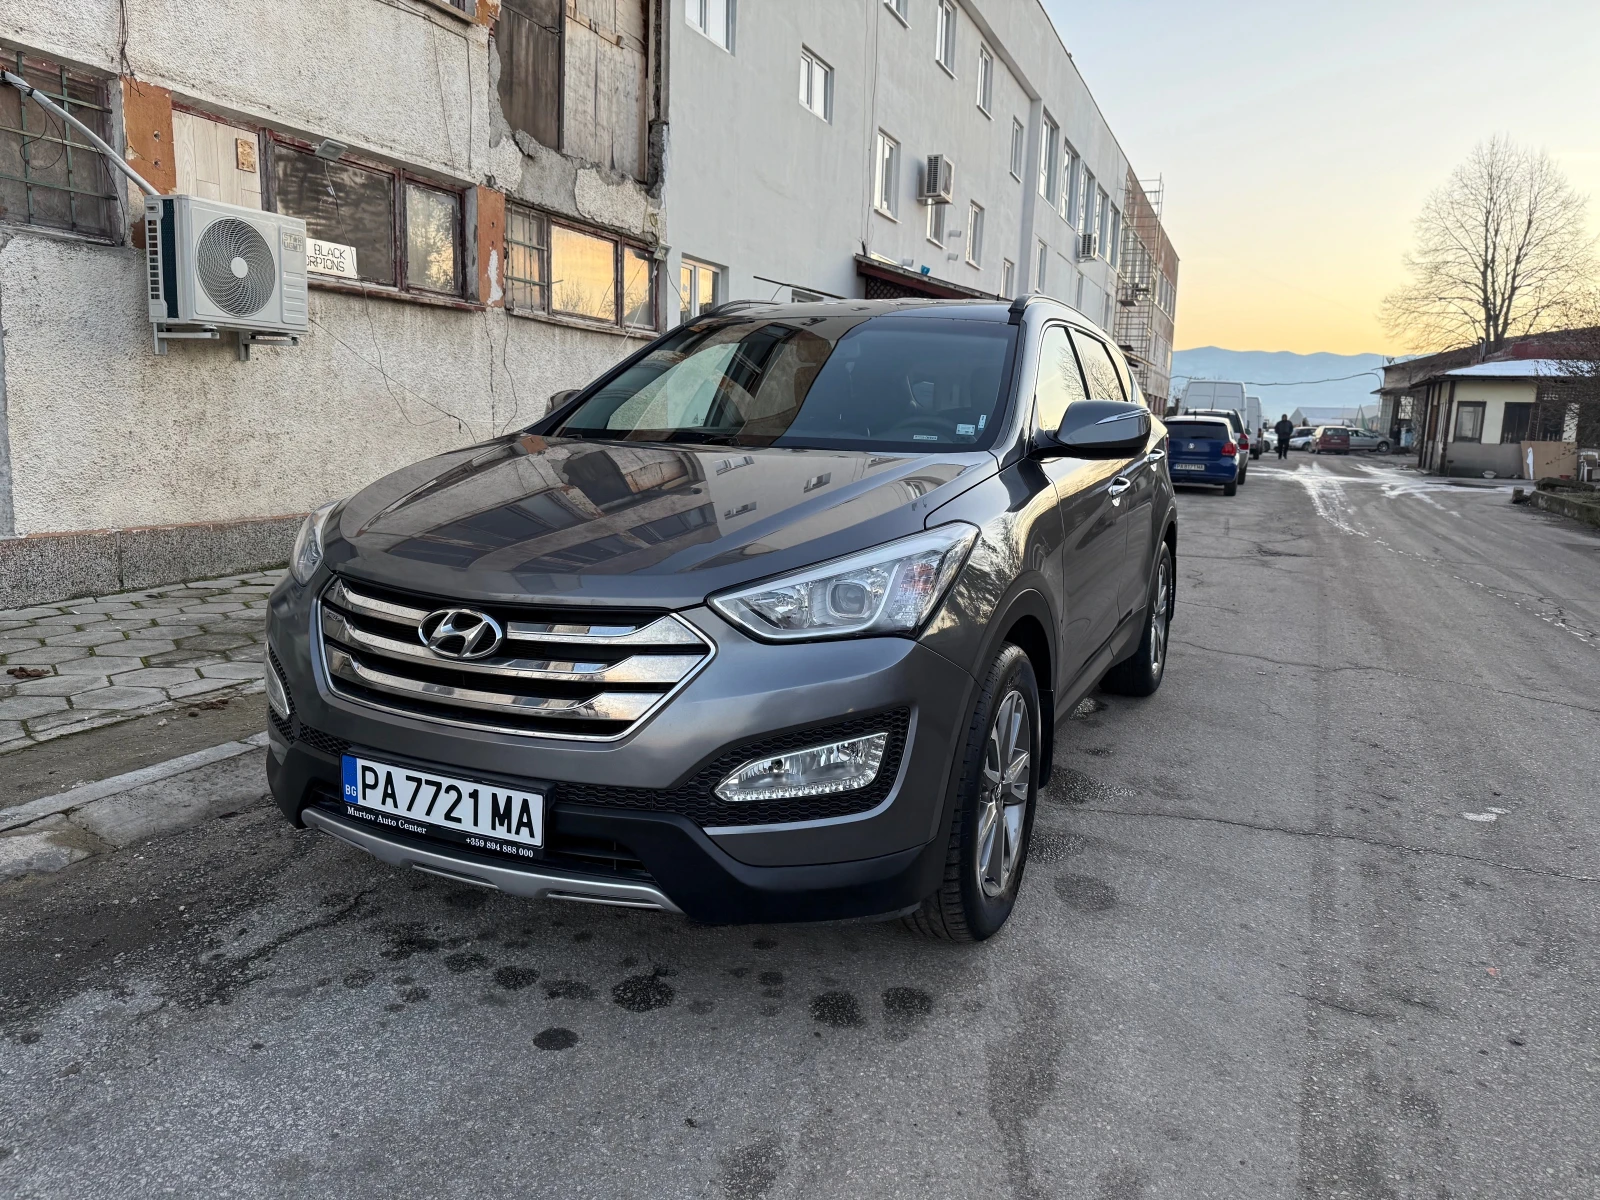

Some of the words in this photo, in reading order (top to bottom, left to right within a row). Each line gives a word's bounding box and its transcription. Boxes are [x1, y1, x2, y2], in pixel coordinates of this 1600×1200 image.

[314, 243, 346, 260] BLACK
[345, 784, 357, 797] BG
[347, 806, 375, 821] Murtov
[376, 813, 396, 827] Auto
[398, 819, 427, 835] Center
[465, 837, 484, 848] +359
[486, 841, 500, 851] 894
[502, 844, 517, 855] 888
[518, 848, 534, 858] 000
